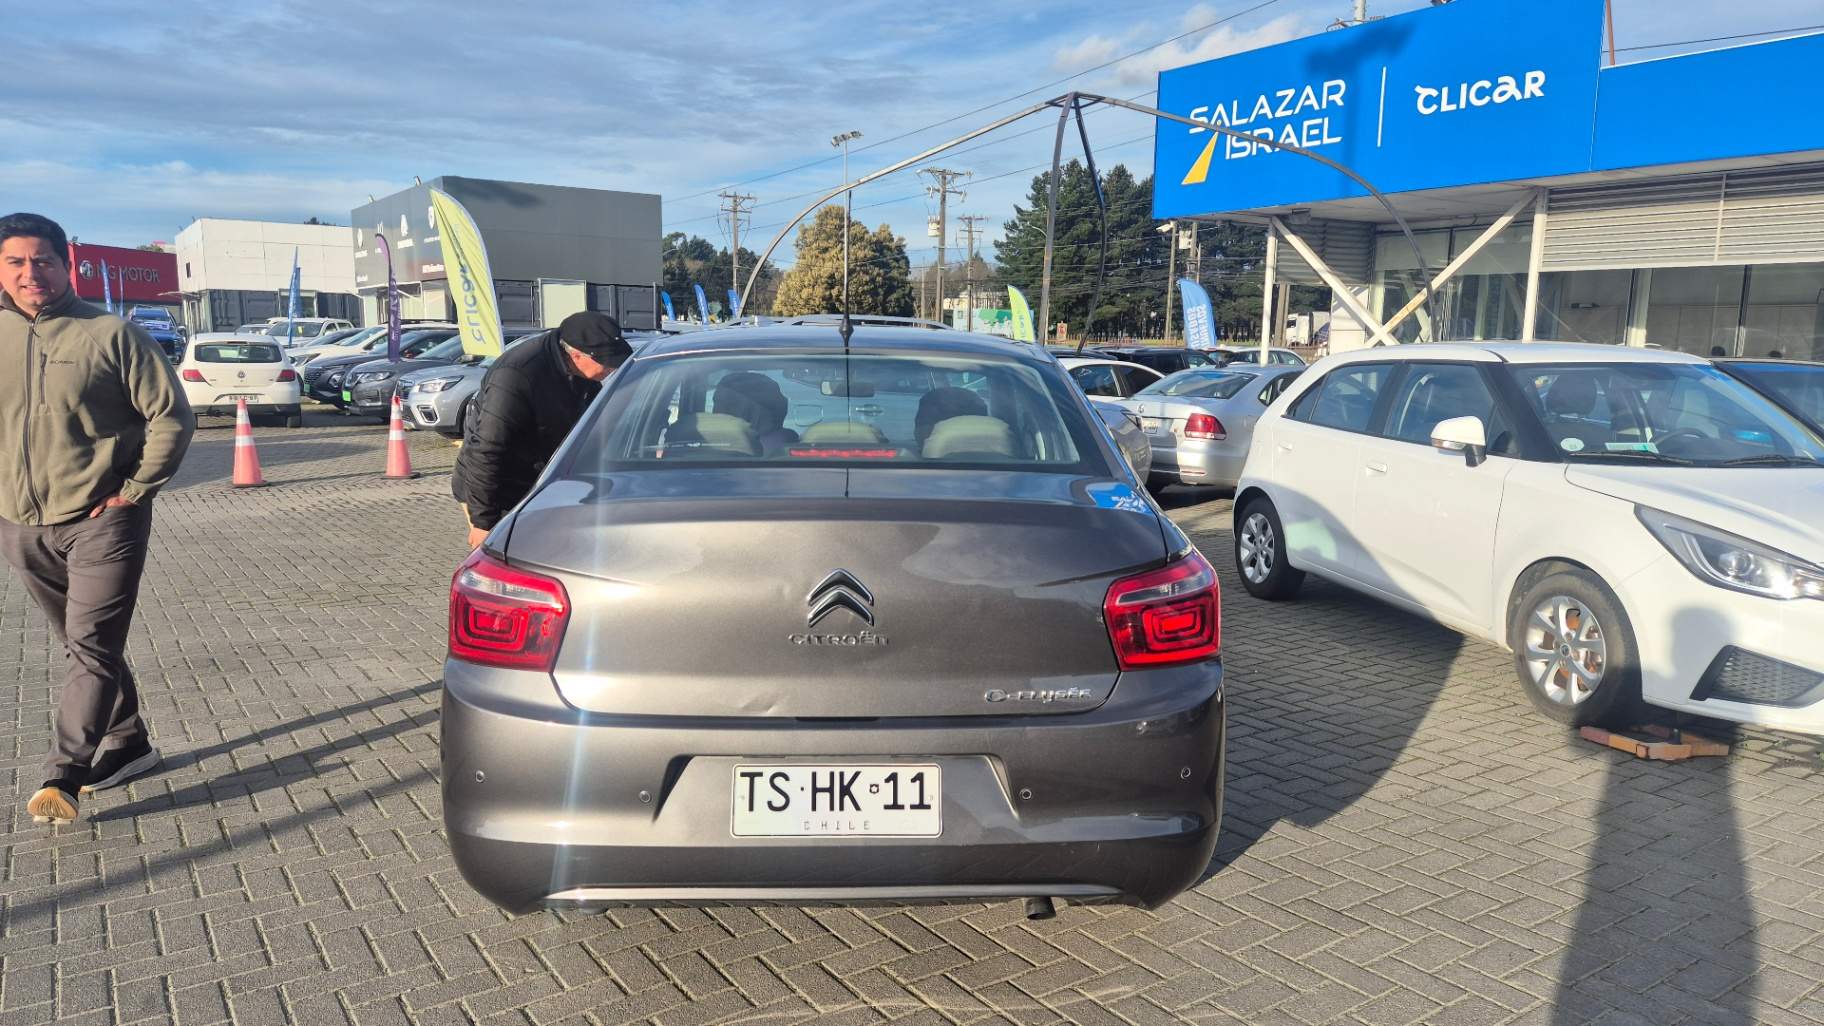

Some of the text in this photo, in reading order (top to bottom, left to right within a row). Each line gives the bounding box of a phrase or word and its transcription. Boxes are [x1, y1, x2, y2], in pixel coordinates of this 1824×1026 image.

[1188, 79, 1346, 135] SALAZAR
[1225, 116, 1342, 160] ISRAEL
[120, 265, 160, 283] MOTOR
[787, 631, 889, 645] CITROËN
[803, 820, 871, 831] CHILE
